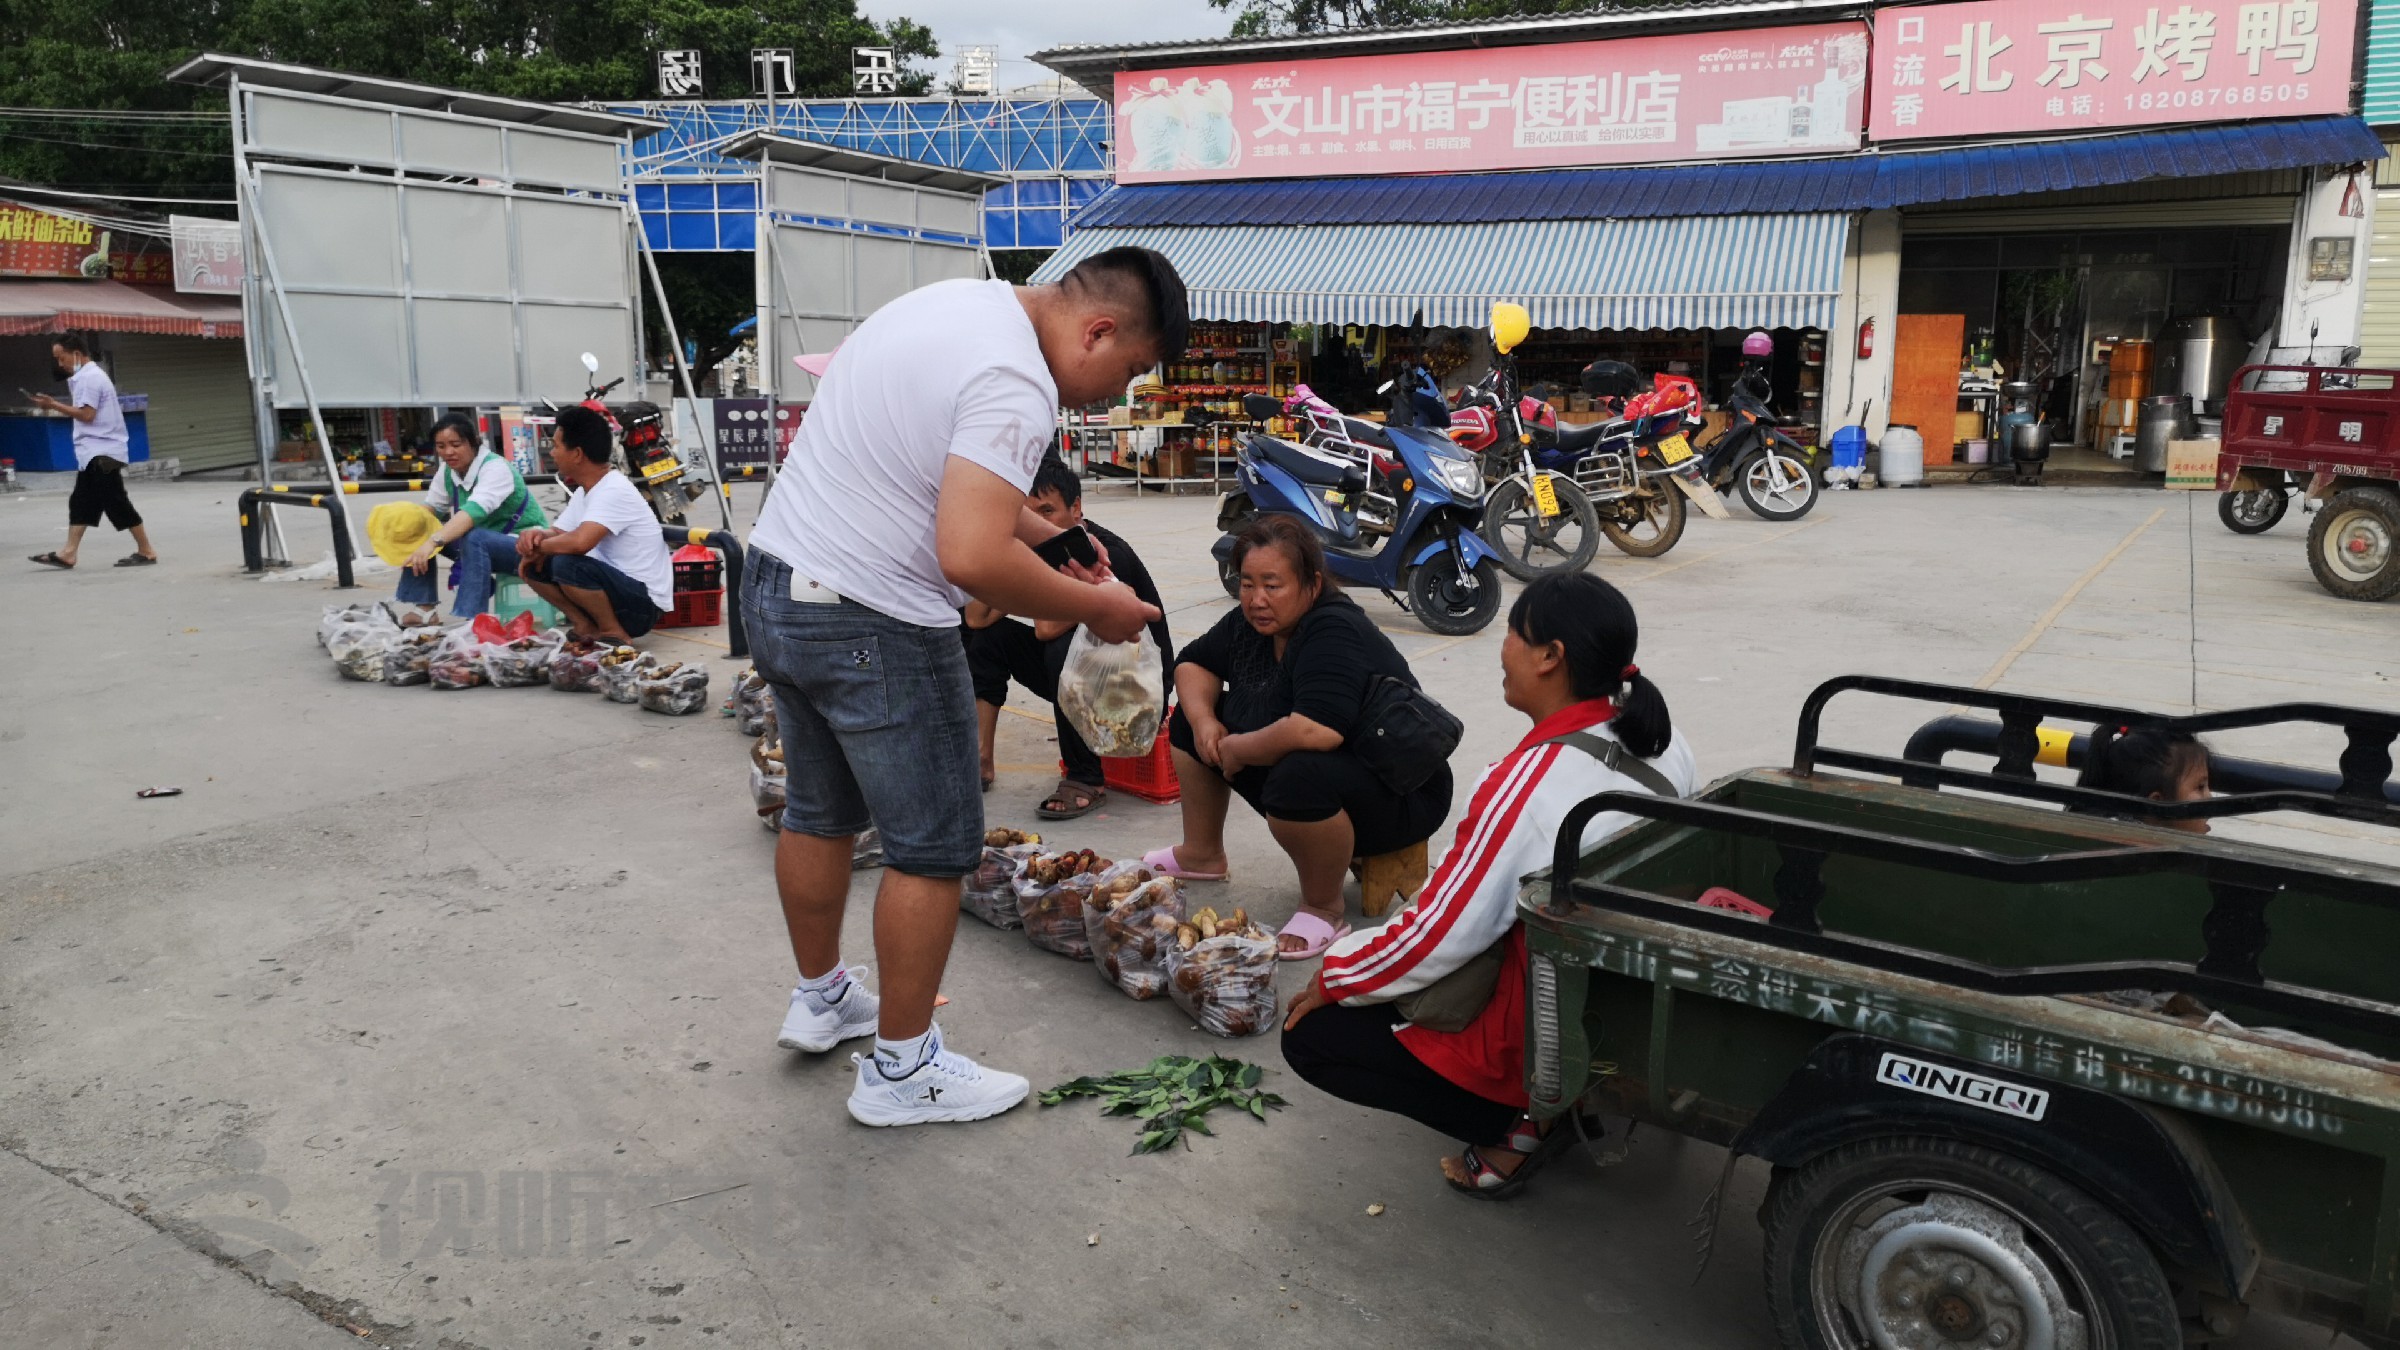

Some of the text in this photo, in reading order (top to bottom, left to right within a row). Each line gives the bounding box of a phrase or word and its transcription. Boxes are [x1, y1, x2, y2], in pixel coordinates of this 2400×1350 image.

[1937, 0, 2320, 95] 北京烤鸭
[1252, 69, 1682, 139] 文山市福宁便利店
[2124, 83, 2310, 111] 18208768505
[1884, 1059, 2042, 1115] QINGQI
